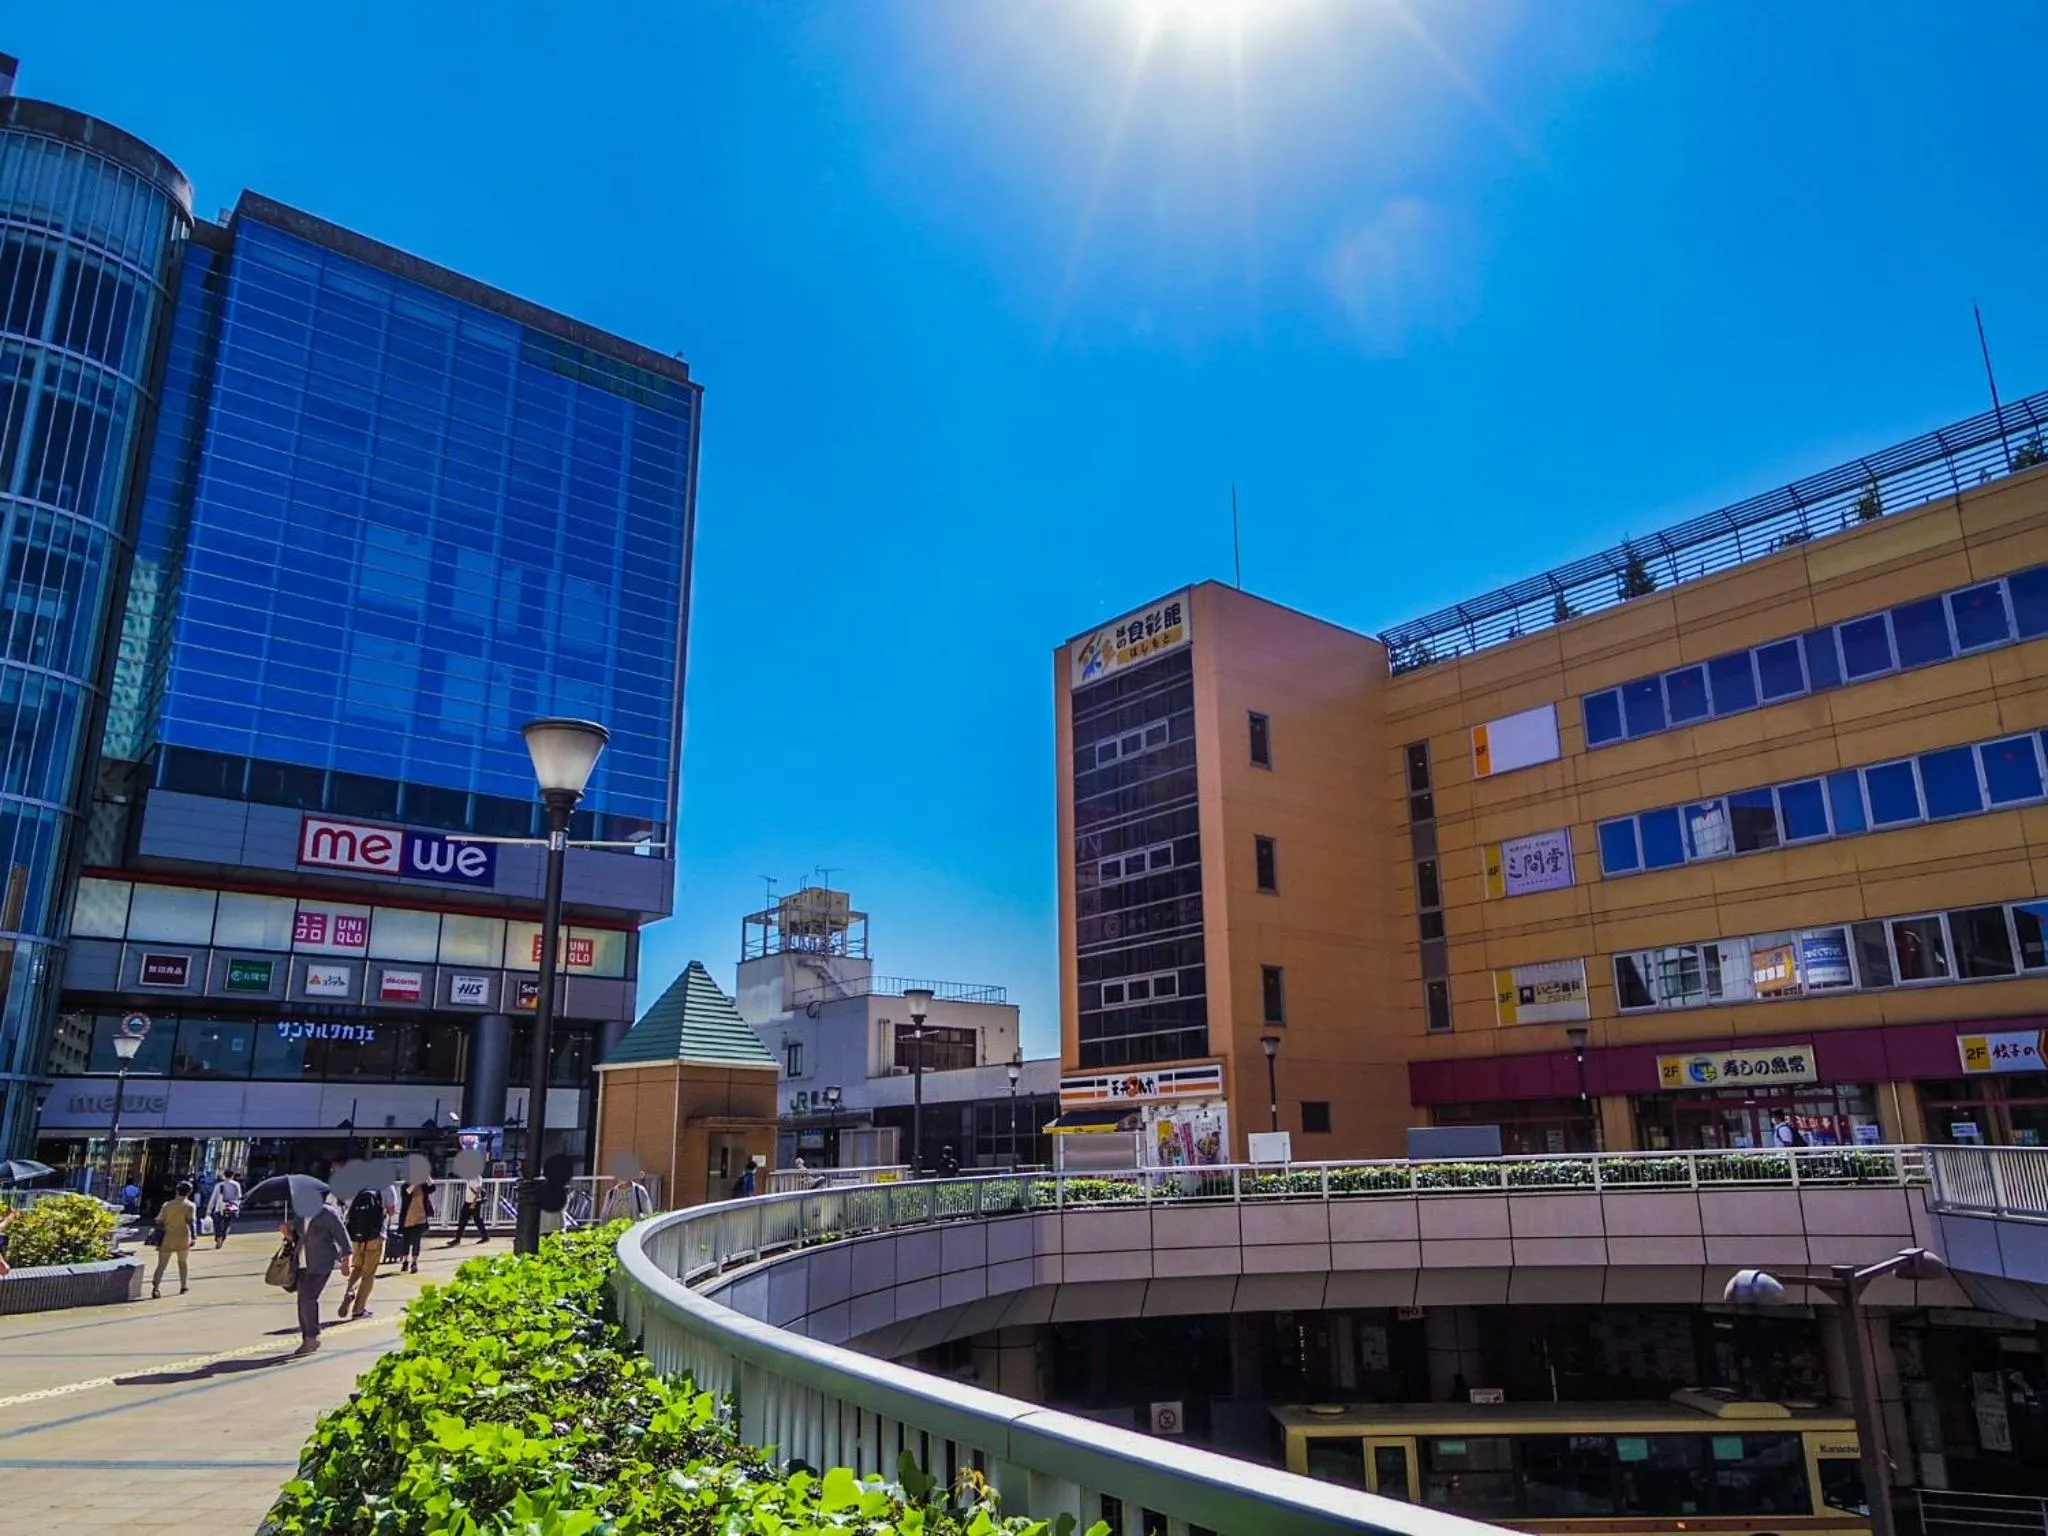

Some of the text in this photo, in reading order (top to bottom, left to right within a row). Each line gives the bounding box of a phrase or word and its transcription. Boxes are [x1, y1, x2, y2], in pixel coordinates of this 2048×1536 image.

[312, 827, 488, 878] me we
[278, 1021, 375, 1040] サンマルクカフェ
[1966, 1043, 2036, 1060] 2F 餃子の
[1663, 1066, 1680, 1078] 2F
[790, 1091, 808, 1110] JR
